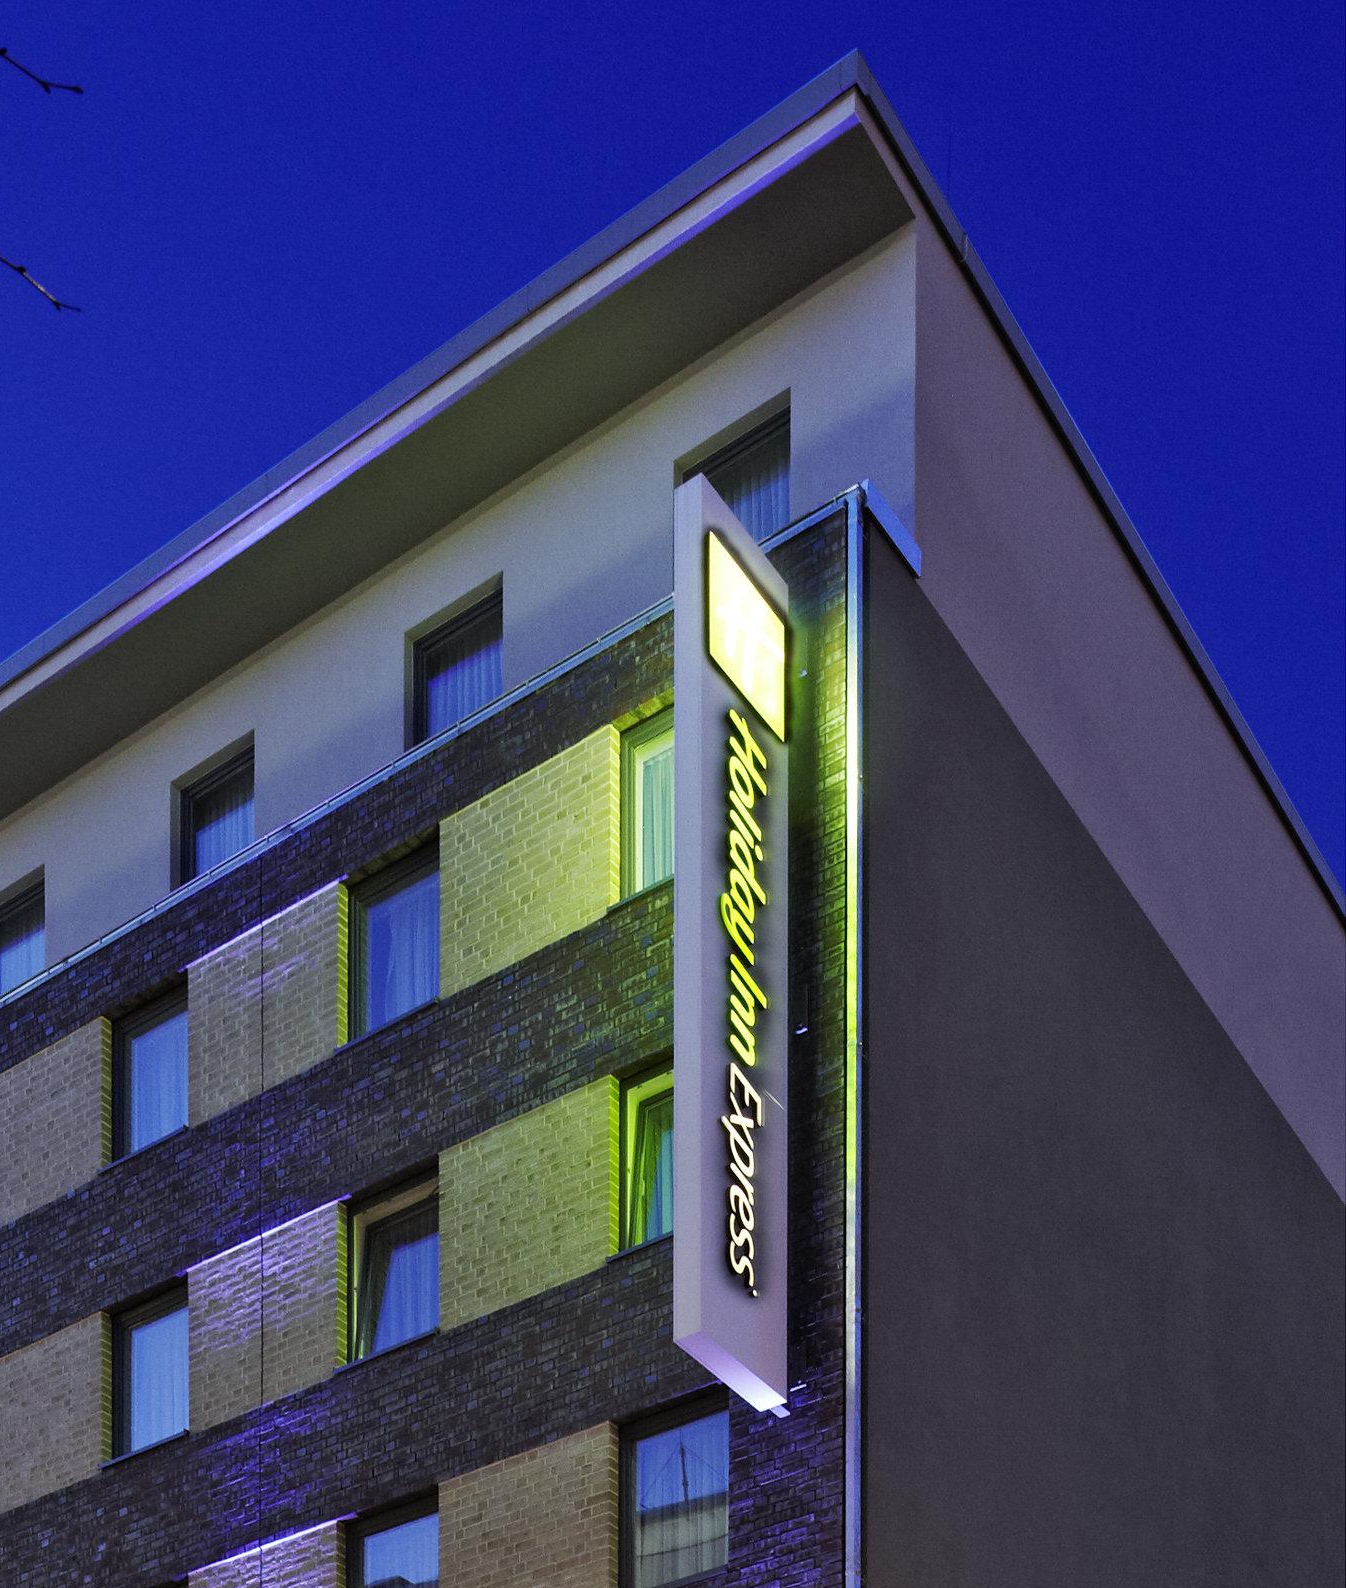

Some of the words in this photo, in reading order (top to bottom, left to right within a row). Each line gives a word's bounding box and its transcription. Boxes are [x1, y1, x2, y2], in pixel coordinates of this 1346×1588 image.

[719, 708, 768, 957] Holiday
[728, 952, 768, 1068] Inn
[721, 1061, 765, 1289] Express
